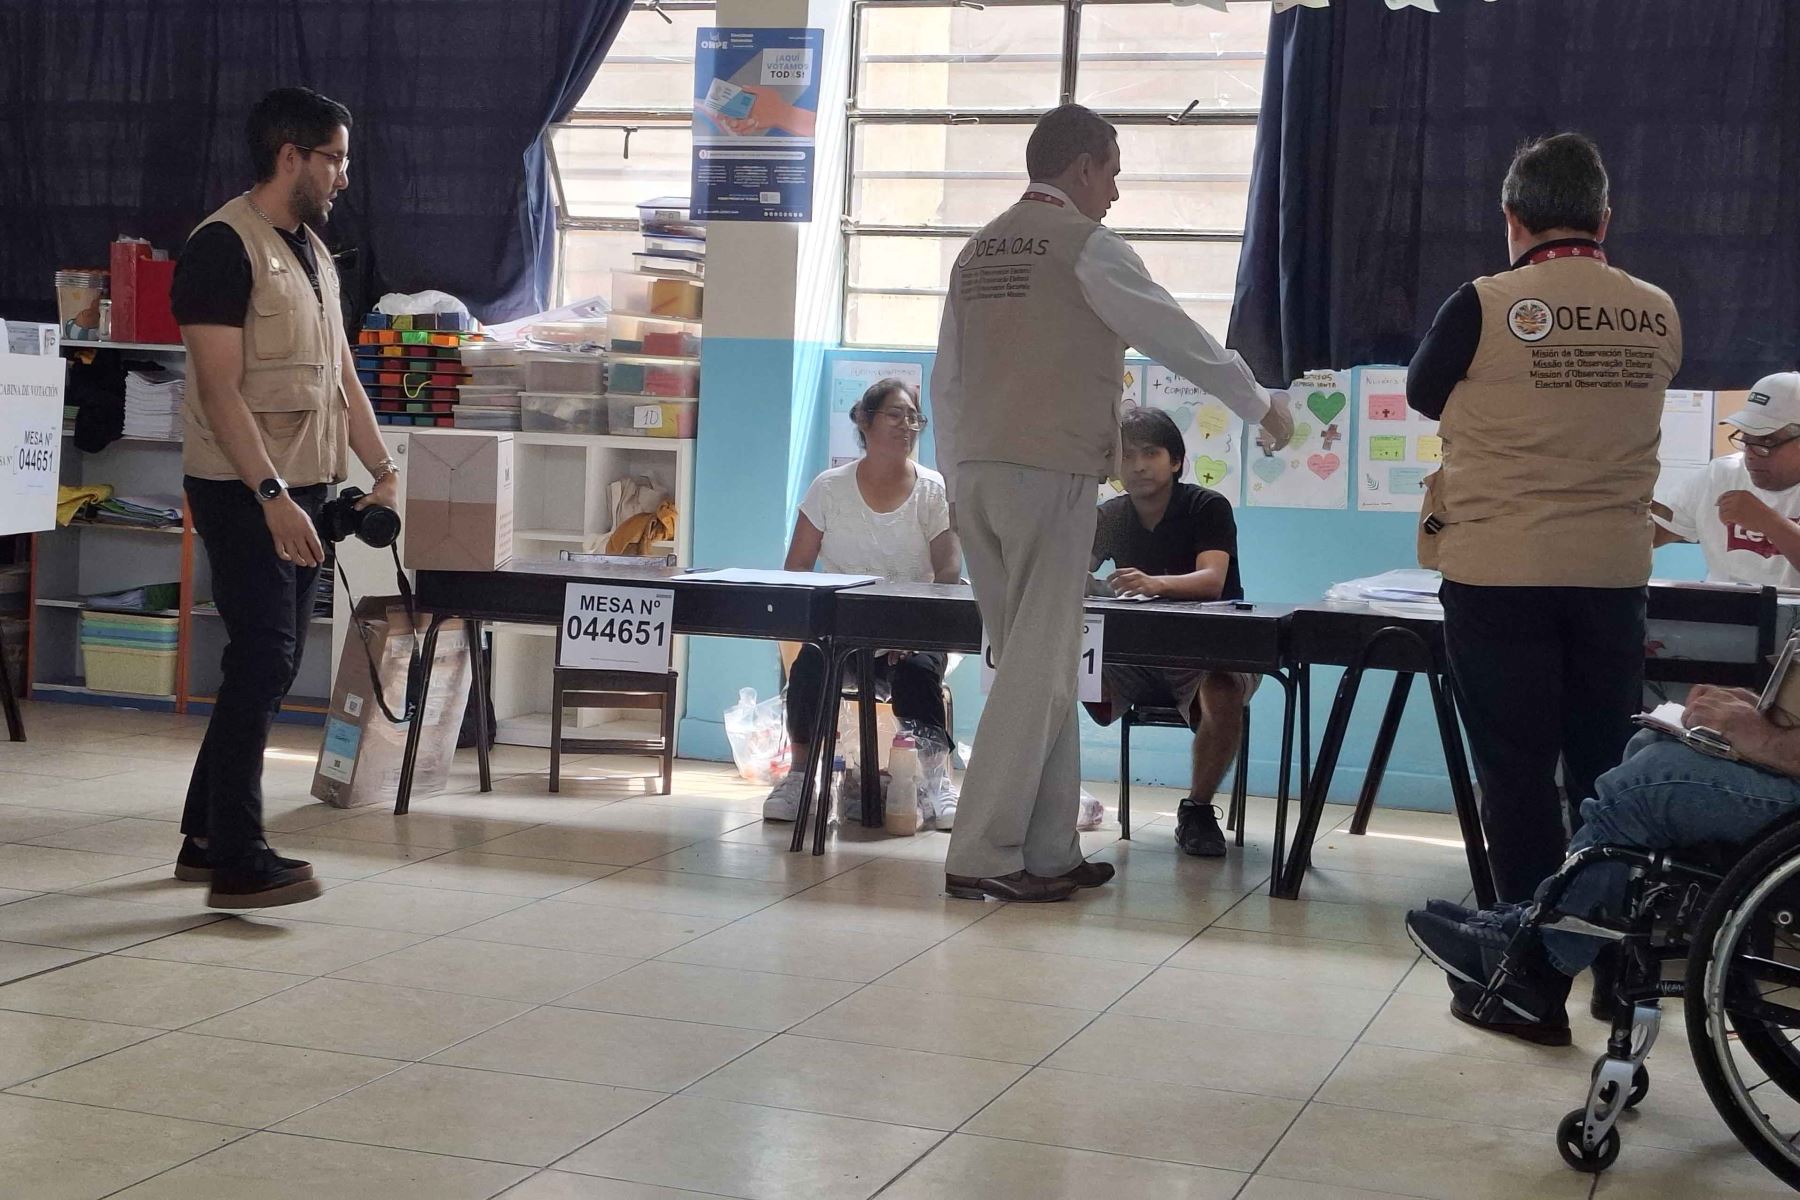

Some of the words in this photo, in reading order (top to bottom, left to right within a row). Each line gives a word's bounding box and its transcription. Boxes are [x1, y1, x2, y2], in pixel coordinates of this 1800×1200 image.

[701, 41, 729, 49] ONPE
[767, 63, 809, 71] VOTAMOS
[1531, 349, 1559, 358] Misión
[1561, 349, 1571, 358] de
[1574, 348, 1622, 358] Observación
[1564, 360, 1574, 368] de
[1535, 380, 1572, 389] Electoral
[1574, 379, 1622, 389] Observation
[24, 430, 43, 447] MESA
[18, 447, 53, 472] 044651
[580, 595, 634, 615] MESA
[567, 615, 665, 647] 044651
